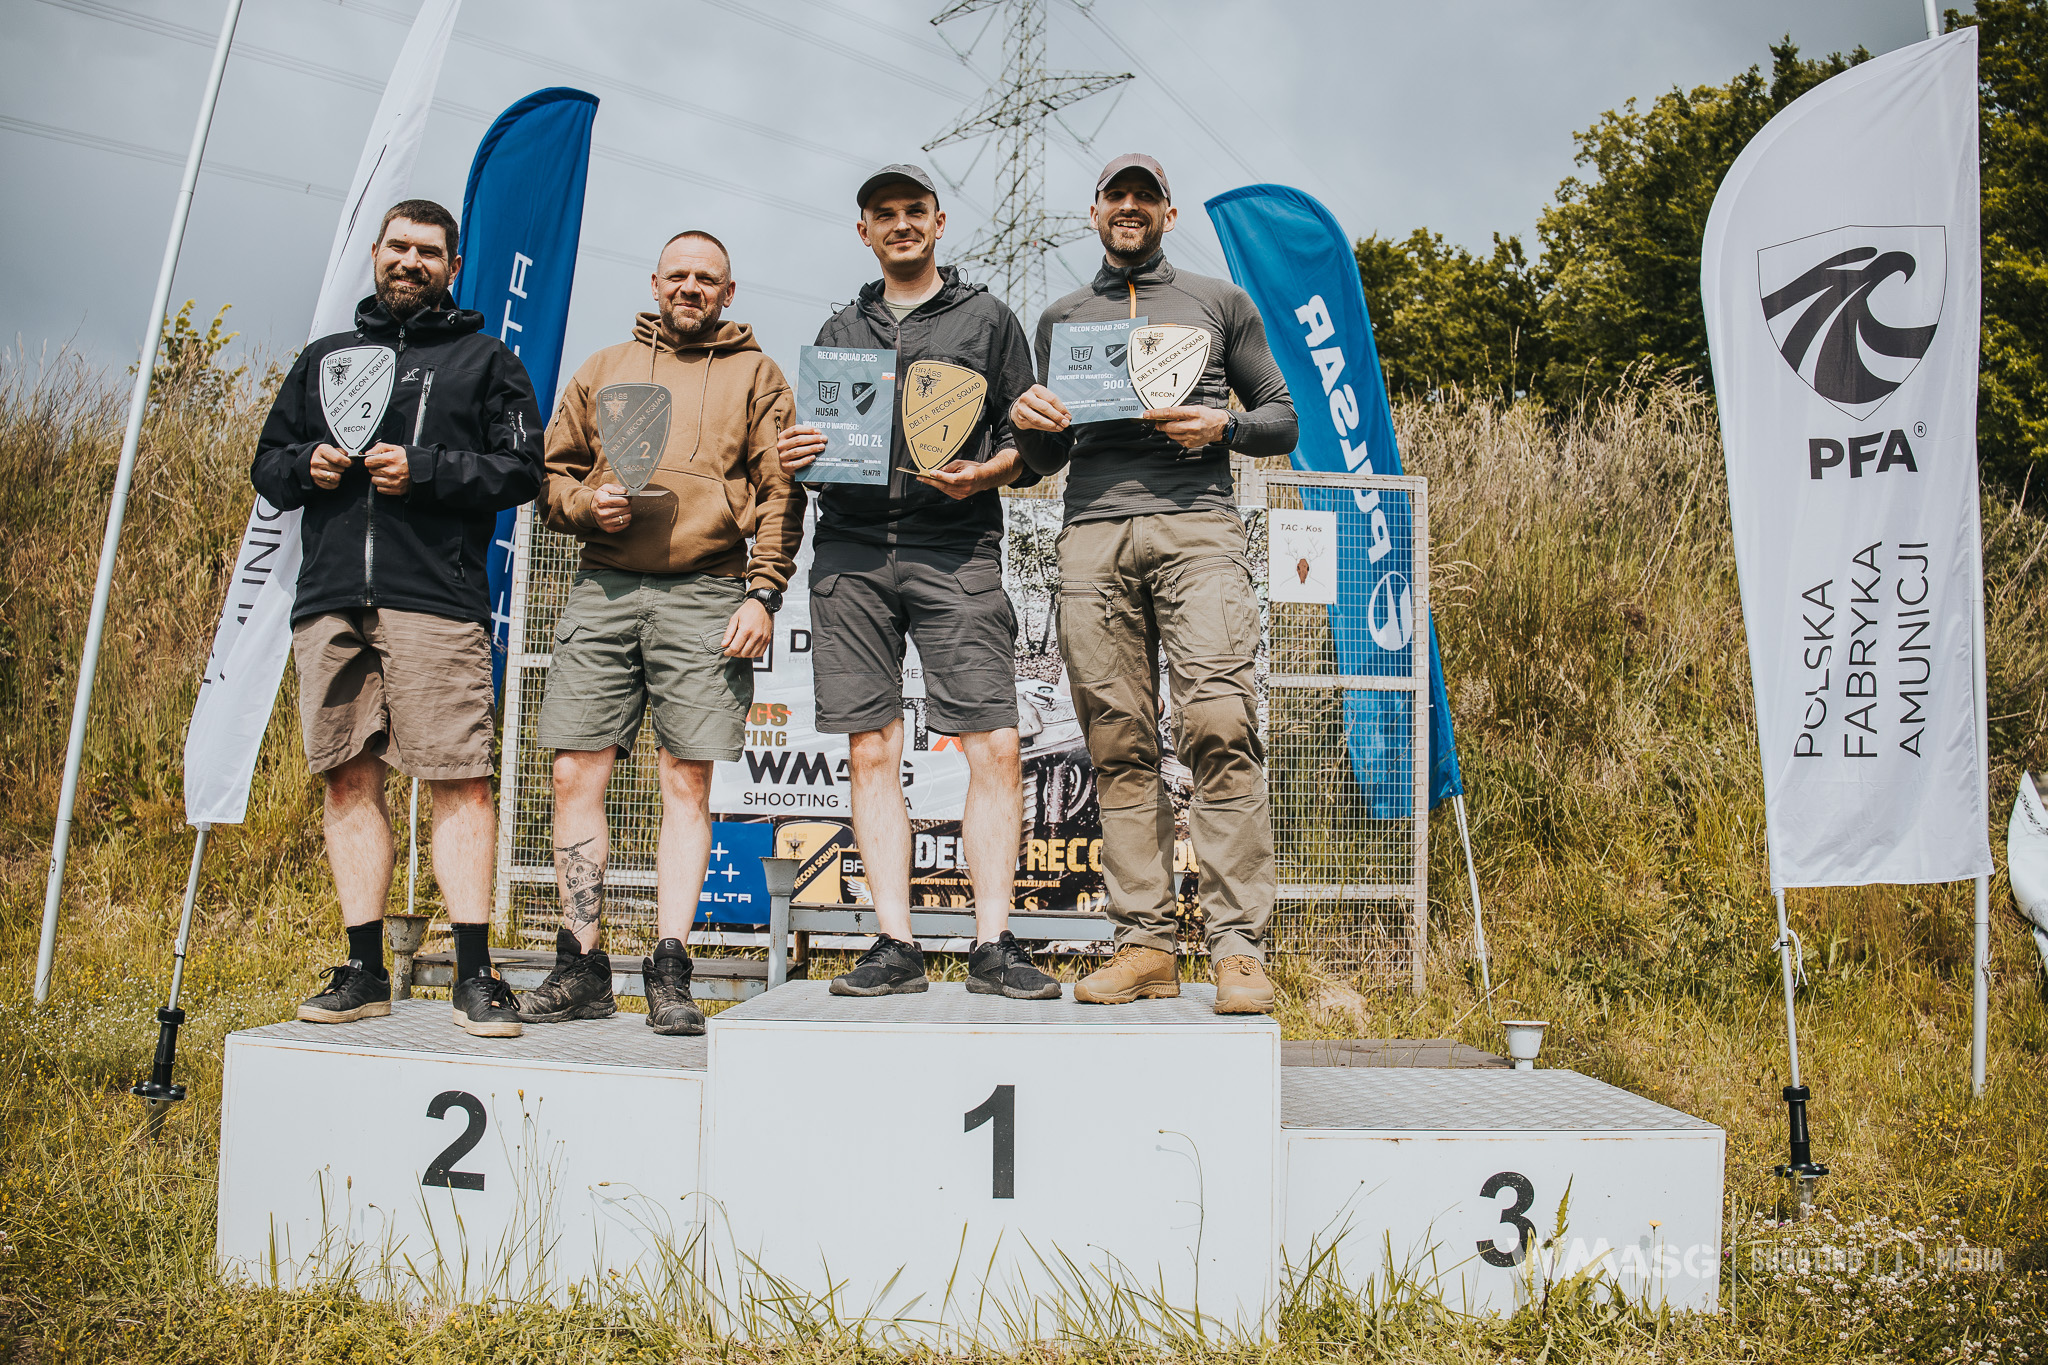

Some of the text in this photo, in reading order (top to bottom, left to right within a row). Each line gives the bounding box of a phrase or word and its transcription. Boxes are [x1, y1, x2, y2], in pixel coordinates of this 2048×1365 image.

[1070, 322, 1130, 333] RECON SQUAD 2025
[818, 351, 878, 362] RECON SQUAD 2025
[1137, 334, 1204, 382] DELTA RECON SQUAD
[330, 354, 390, 418] DELTA RECON SQUAD
[1103, 379, 1134, 390] 900 Z
[1172, 373, 1178, 387] 1
[361, 402, 372, 419] 2
[815, 407, 839, 417] HUSAR
[908, 382, 980, 429] DELTA RECON SQUAD
[343, 425, 366, 433] RECON
[609, 393, 666, 455] DELTA RECON SQUAD
[942, 424, 949, 441] 1
[640, 441, 650, 459] 2
[848, 434, 883, 447] 900 ZŁ
[920, 443, 943, 453] RECON
[1808, 429, 1918, 480] PFA
[1844, 541, 1883, 758] FABRYKA
[1896, 542, 1931, 759] AMUNICJI
[1793, 578, 1835, 758] POLSKA
[743, 792, 839, 808] SHOOTING
[814, 842, 840, 868] SQUAD
[1026, 838, 1104, 873] RECO
[699, 892, 752, 904] ELTA
[422, 1090, 486, 1192] 2
[963, 1084, 1014, 1200] 1
[1476, 1171, 1537, 1268] 3
